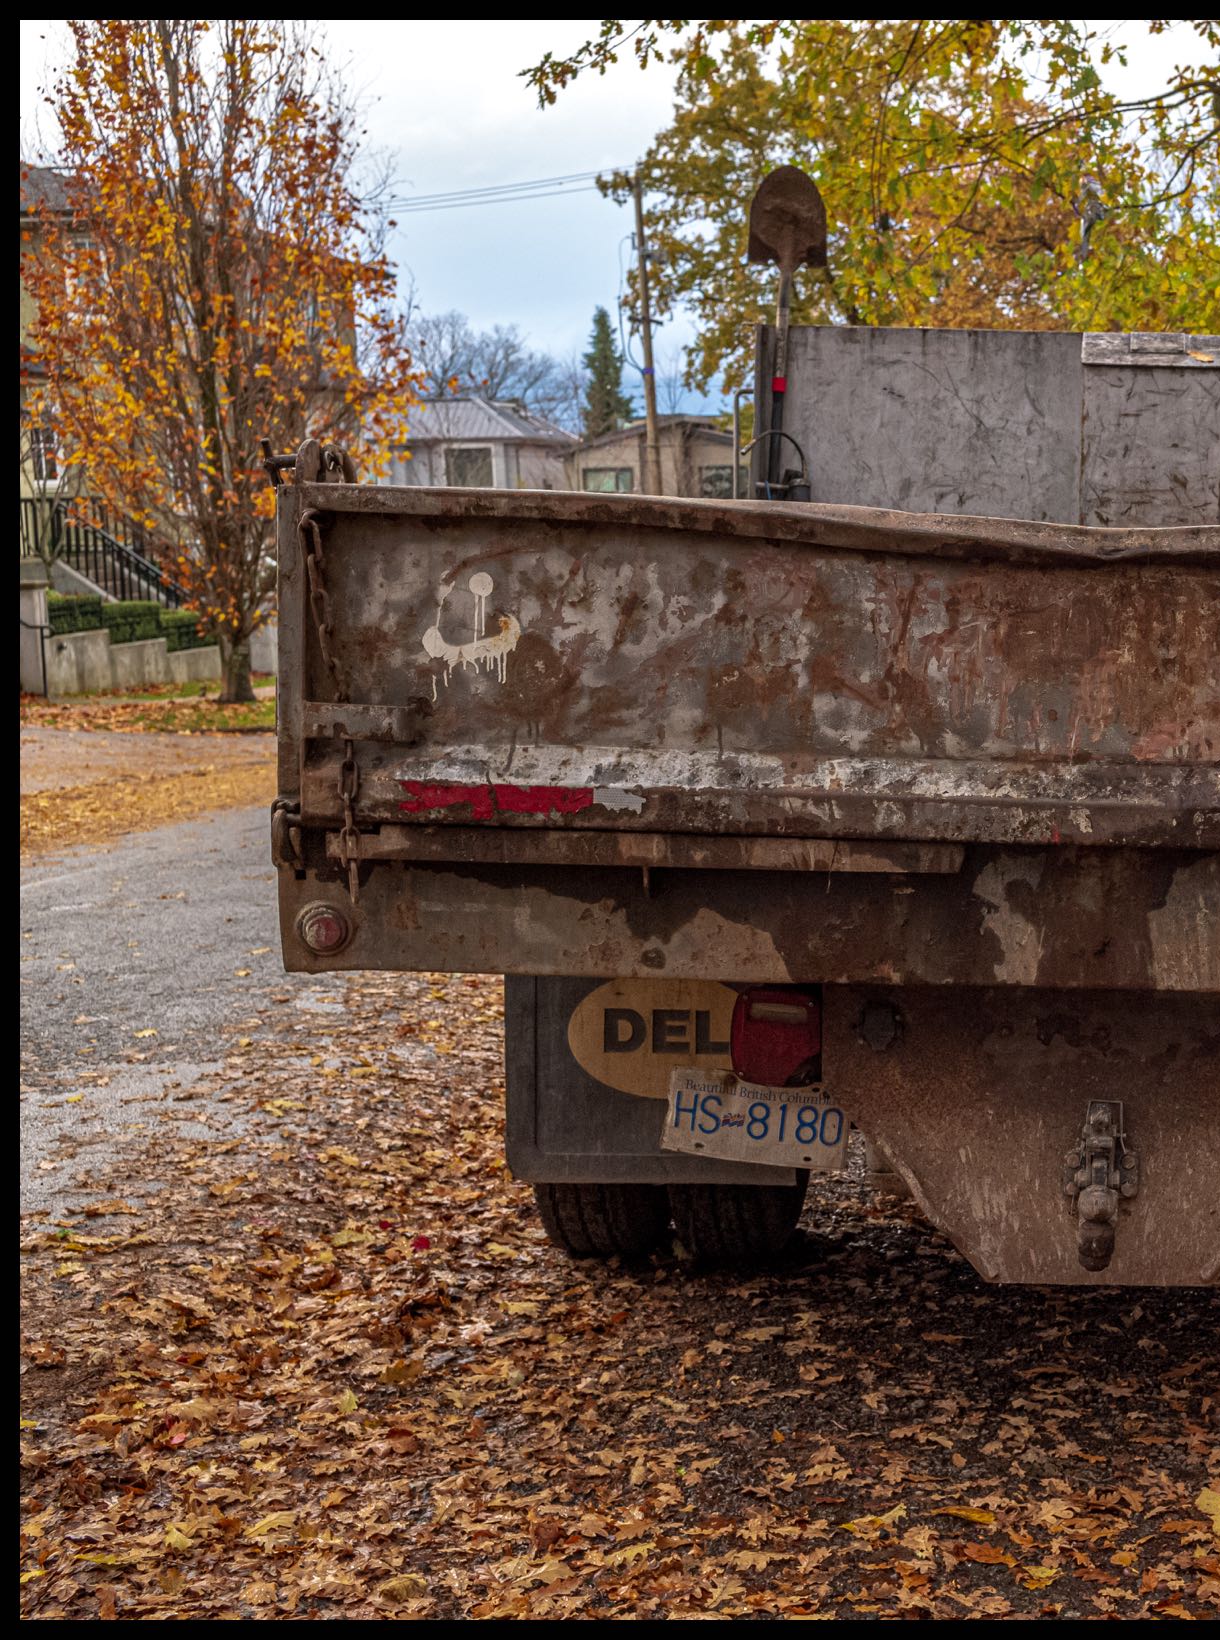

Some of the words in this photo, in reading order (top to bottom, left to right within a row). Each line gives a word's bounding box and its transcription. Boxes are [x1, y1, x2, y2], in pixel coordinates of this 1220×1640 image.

[603, 1007, 731, 1056] DEL
[674, 1090, 723, 1134] HS
[746, 1101, 844, 1147] 8180
[740, 1086, 777, 1102] British
